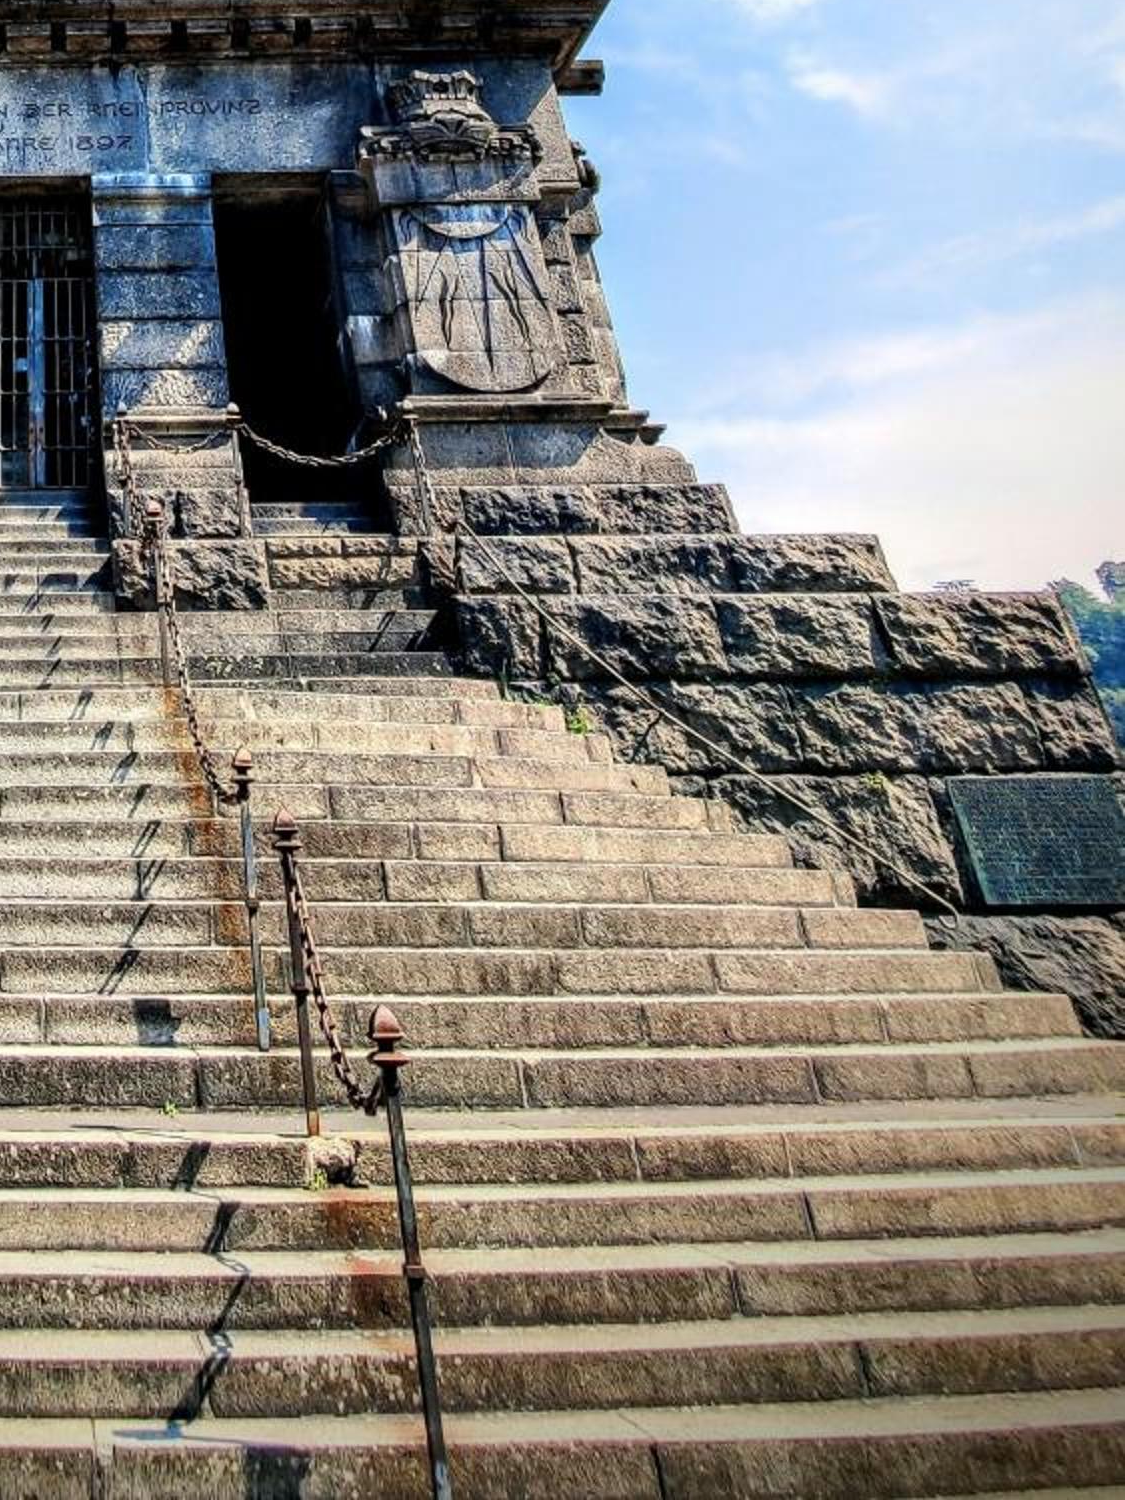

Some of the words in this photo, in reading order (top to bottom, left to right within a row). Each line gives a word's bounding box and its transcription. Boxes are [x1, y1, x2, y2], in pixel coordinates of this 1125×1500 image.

[22, 103, 74, 117] DER
[89, 100, 261, 116] RHEIPROVINZ
[69, 135, 132, 151] 1897
